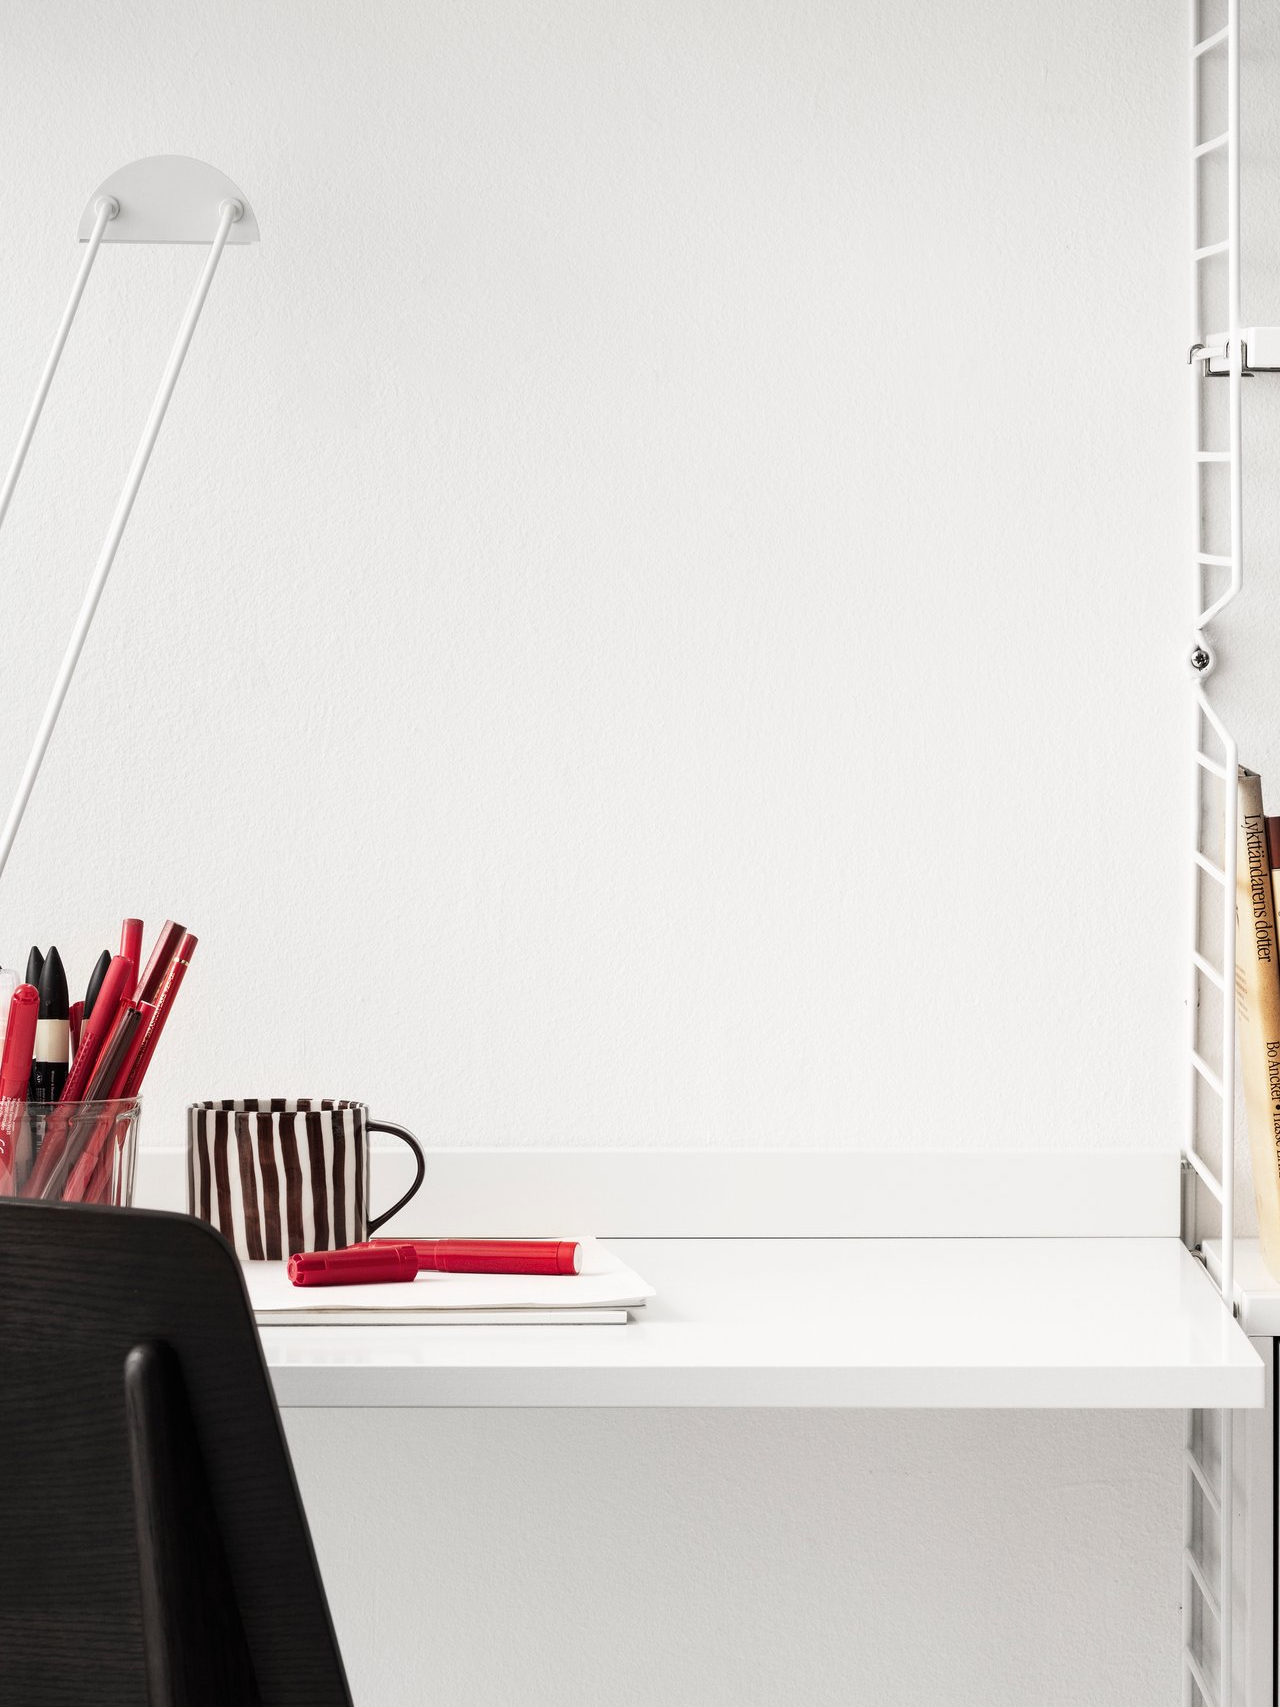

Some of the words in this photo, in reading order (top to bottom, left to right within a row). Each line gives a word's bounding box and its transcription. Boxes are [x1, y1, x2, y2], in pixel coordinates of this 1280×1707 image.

[1241, 814, 1267, 918] Lykttändarens
[1254, 919, 1271, 962] dotter
[1266, 1040, 1280, 1057] Bo
